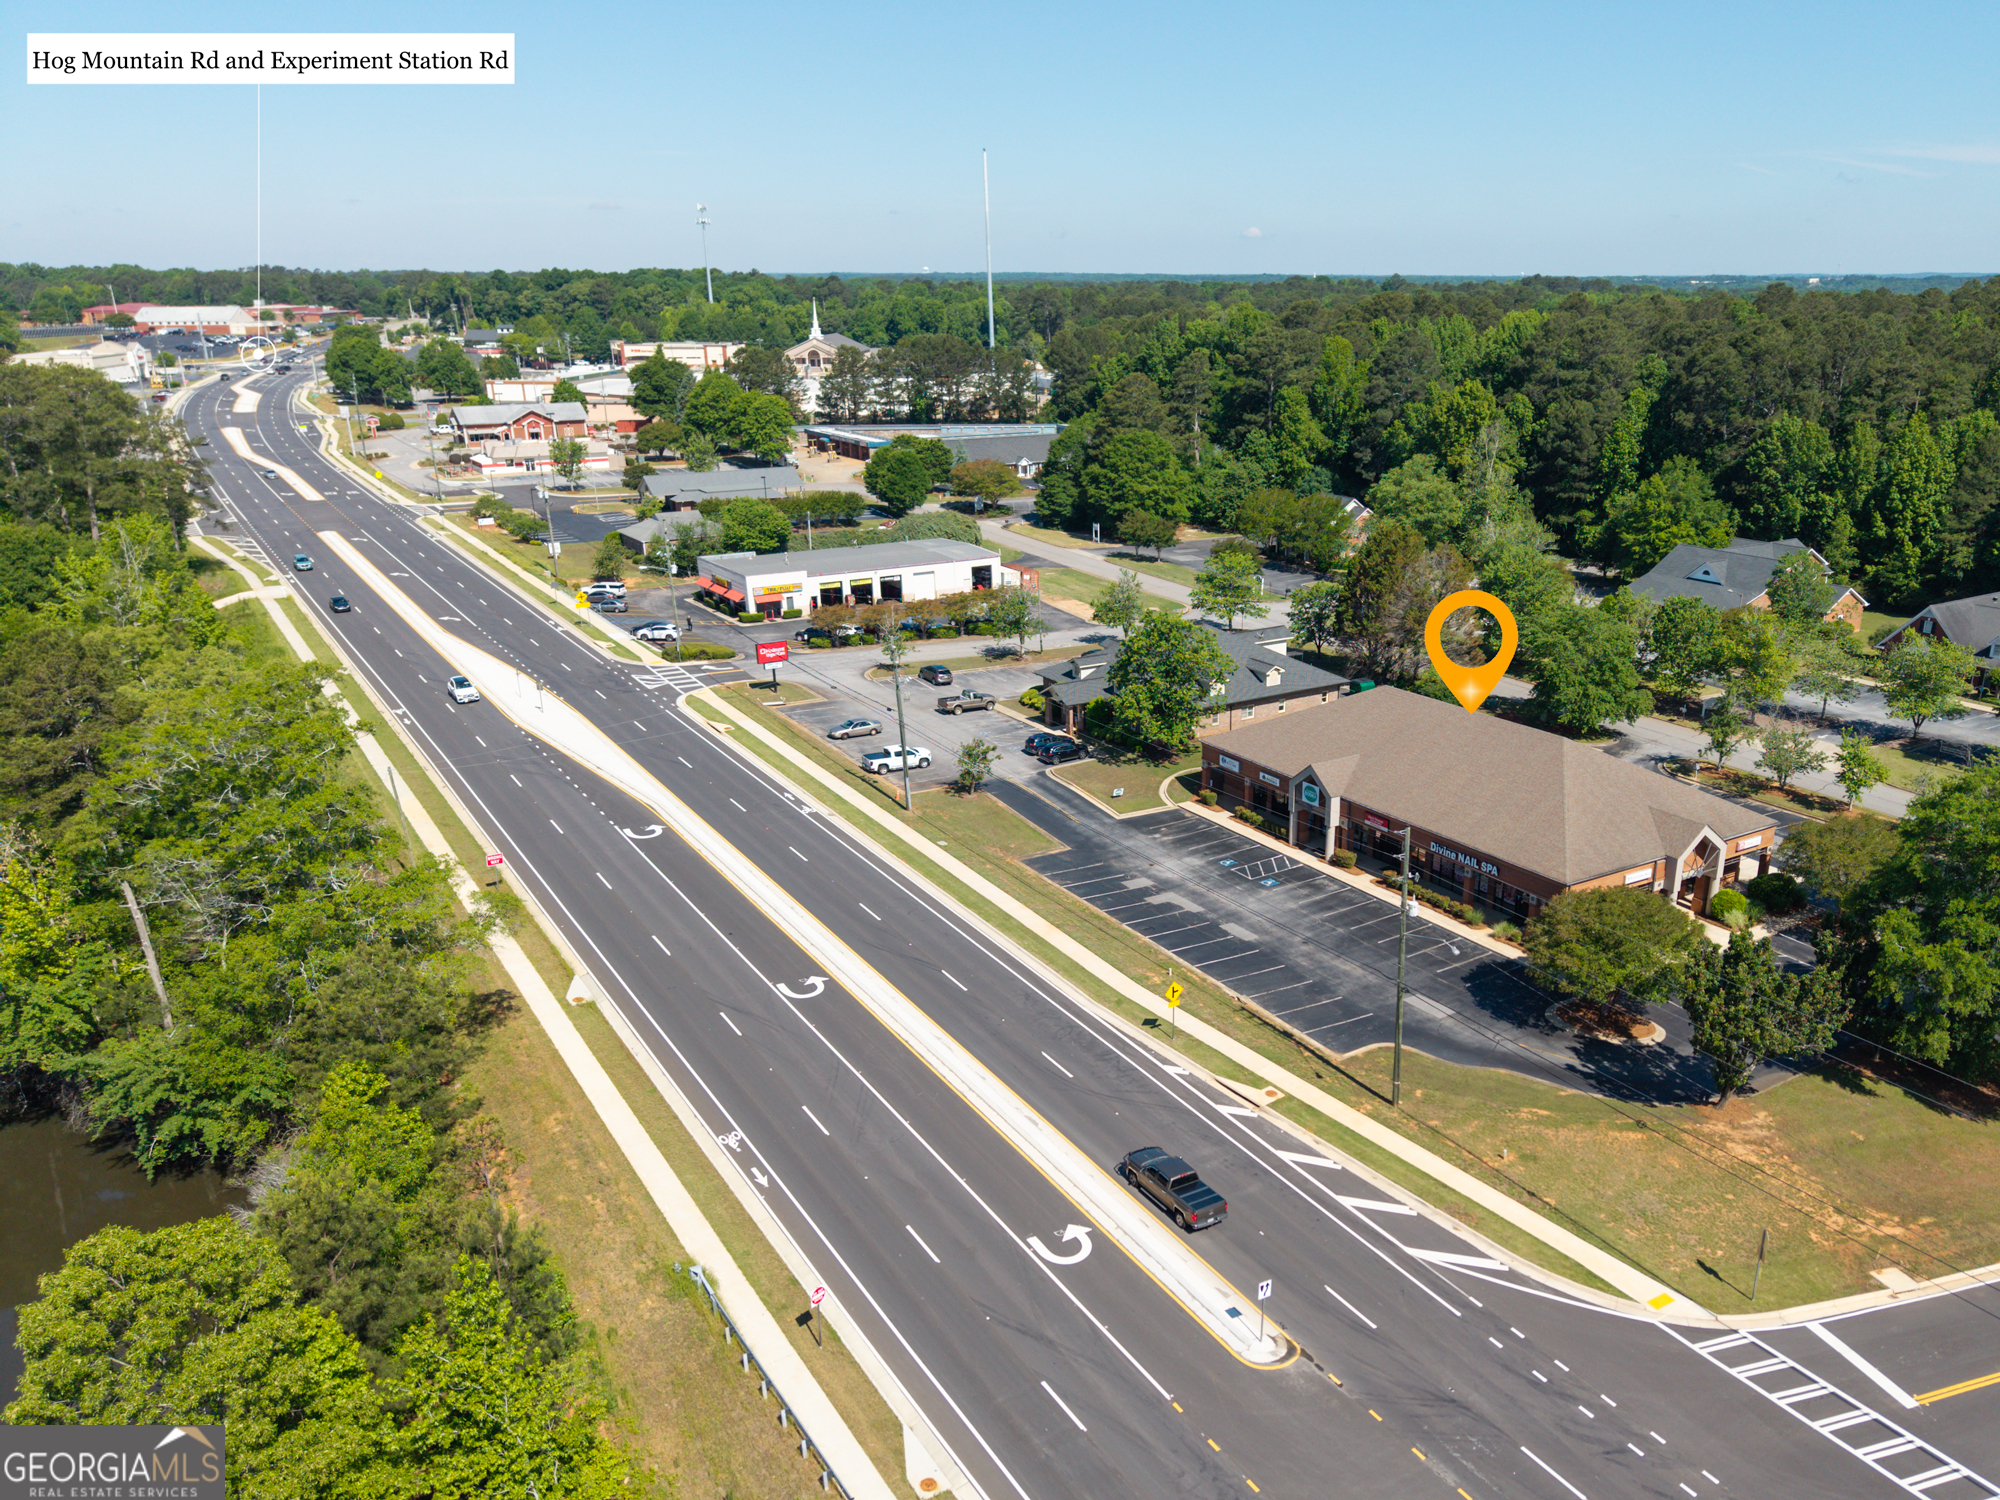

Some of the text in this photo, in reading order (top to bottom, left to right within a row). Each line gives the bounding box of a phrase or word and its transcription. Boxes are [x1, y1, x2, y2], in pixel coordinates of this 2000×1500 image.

[1431, 841, 1498, 876] Divine NAIL SPA
